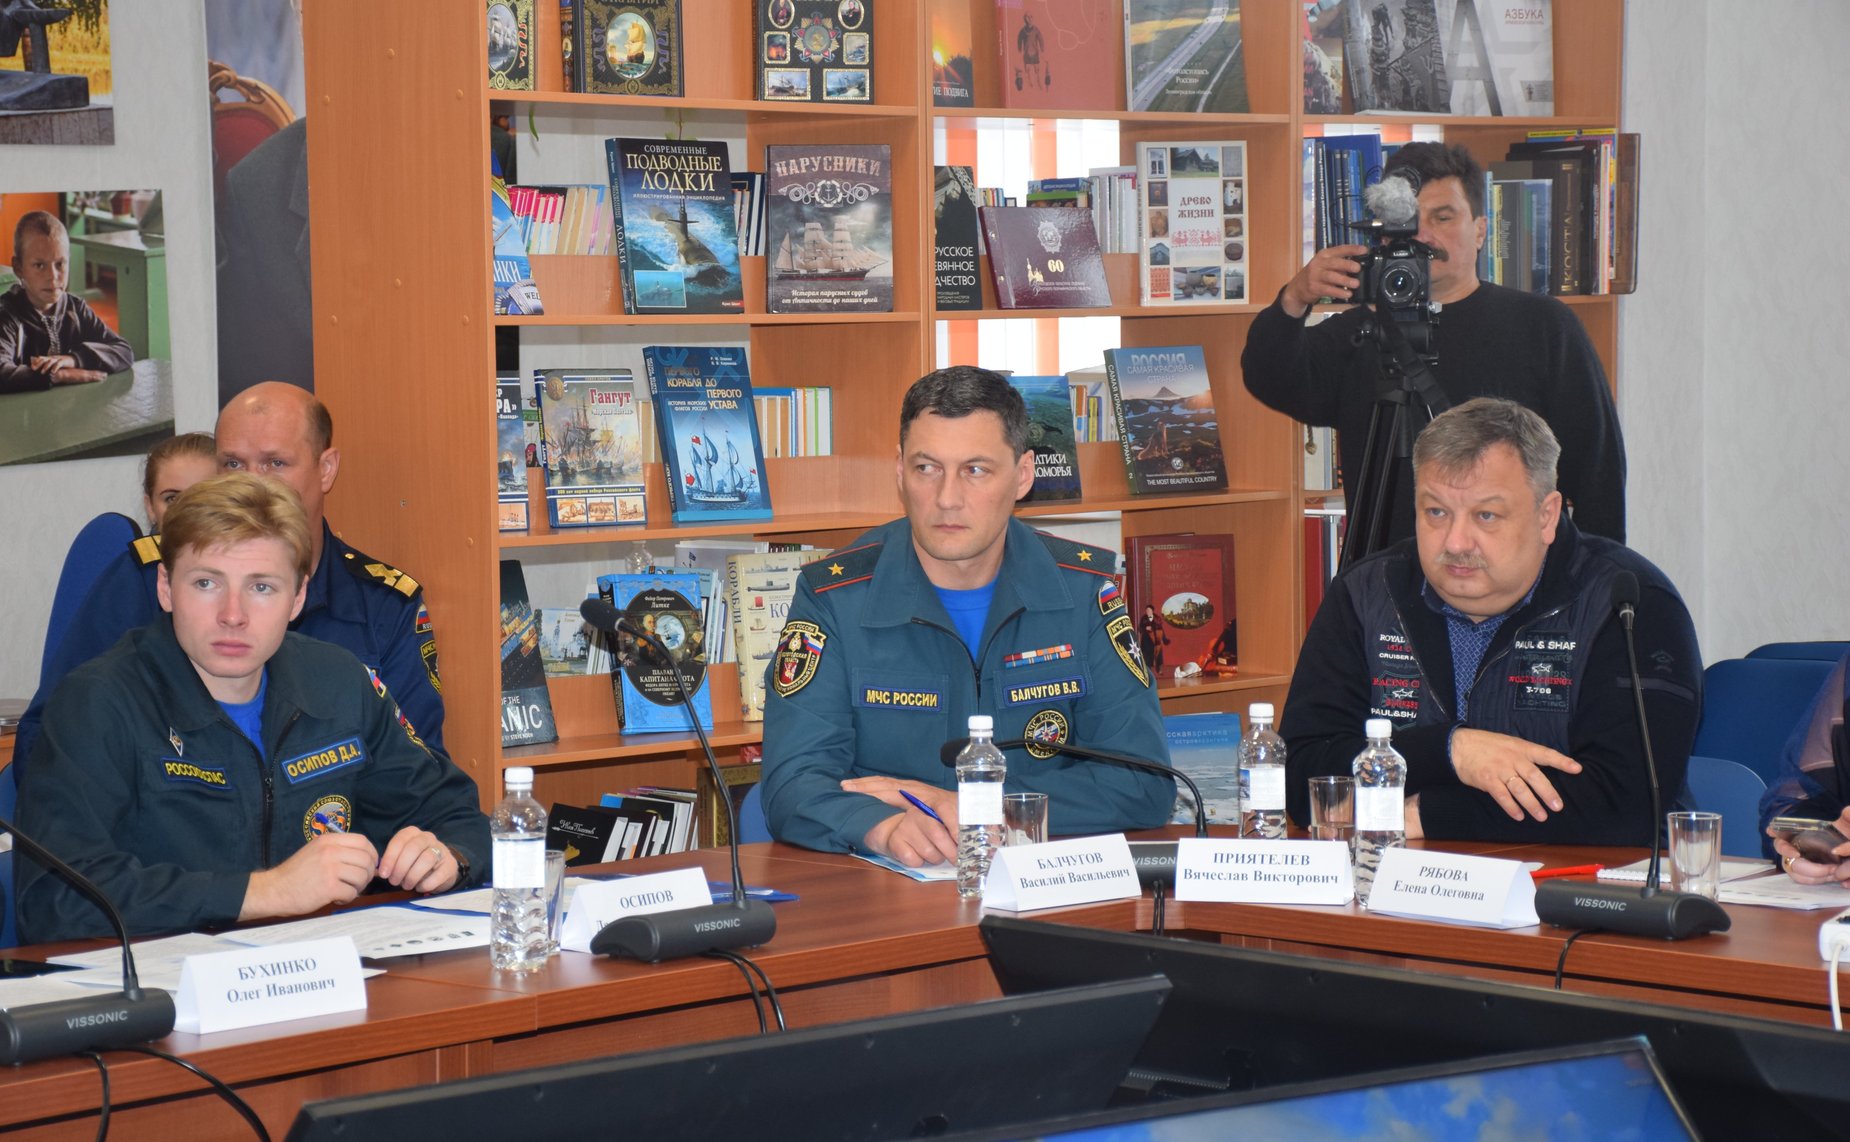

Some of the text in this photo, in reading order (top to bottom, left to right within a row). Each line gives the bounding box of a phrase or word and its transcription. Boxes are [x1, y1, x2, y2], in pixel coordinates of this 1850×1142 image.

[1505, 8, 1544, 19] АЗБУКА
[944, 87, 968, 98] ПОДВИГА
[644, 144, 708, 155] СОВРЕМЕННЫЕ
[626, 153, 722, 172] ПОДВОДНЫЕ
[775, 155, 882, 177] ПАРУСНИКИ
[641, 170, 715, 193] ЛОДКИ
[1180, 196, 1212, 207] ДРЕВО
[1178, 209, 1215, 218] ЖИЗНИ
[616, 224, 626, 264] ЛОДКИ
[934, 246, 974, 257] РУССКОЕ
[1048, 260, 1064, 272] 60
[934, 276, 976, 287] ДЧЕСТВО
[1131, 353, 1186, 366] РОССИЯ
[1127, 364, 1194, 374] САМАЯ КРАСИВАЯ
[668, 378, 717, 387] КОРАБЛЯ ДО
[1147, 375, 1176, 384] СТРАНА
[589, 388, 631, 407] Гангут
[706, 389, 742, 398] ПЕРВОГО
[709, 400, 738, 410] УСТАВА
[1108, 364, 1134, 480] САМАЯ КРАСИВАЯ СТРАНА 2
[1170, 477, 1194, 485] BEAUTIFUL
[728, 561, 742, 624] КОРАБЛИ
[1380, 634, 1405, 643] ROYAL
[1515, 641, 1534, 649] PAUL
[1536, 641, 1545, 649] &
[1379, 652, 1409, 660] CRUISER
[1372, 677, 1409, 687] RACING
[866, 689, 937, 707] МЧС РОССИИ
[1011, 681, 1080, 702] БАЛЧУГОВ В.В.
[507, 696, 520, 704] THE
[1040, 714, 1064, 728] РОССИИ
[286, 744, 361, 777] ОСИПОВ Д.А.
[1037, 852, 1103, 870] БАЛЧУГОВ
[1213, 852, 1310, 866] ПРИЯТЕЛЕВ
[1020, 868, 1130, 889] Василий Васильевич
[1184, 869, 1338, 885] Вячеслав Викторович
[1419, 865, 1469, 882] РЯБОВА
[1394, 881, 1484, 901] Елена Олеговна
[620, 890, 674, 910] ОСИПОВ
[1574, 897, 1627, 912] VISSONIC
[694, 918, 740, 933] VISSONIC
[238, 958, 317, 982] БУХИНКО
[227, 978, 336, 1003] Олег Иванович
[66, 1011, 128, 1029] VISSONIC
